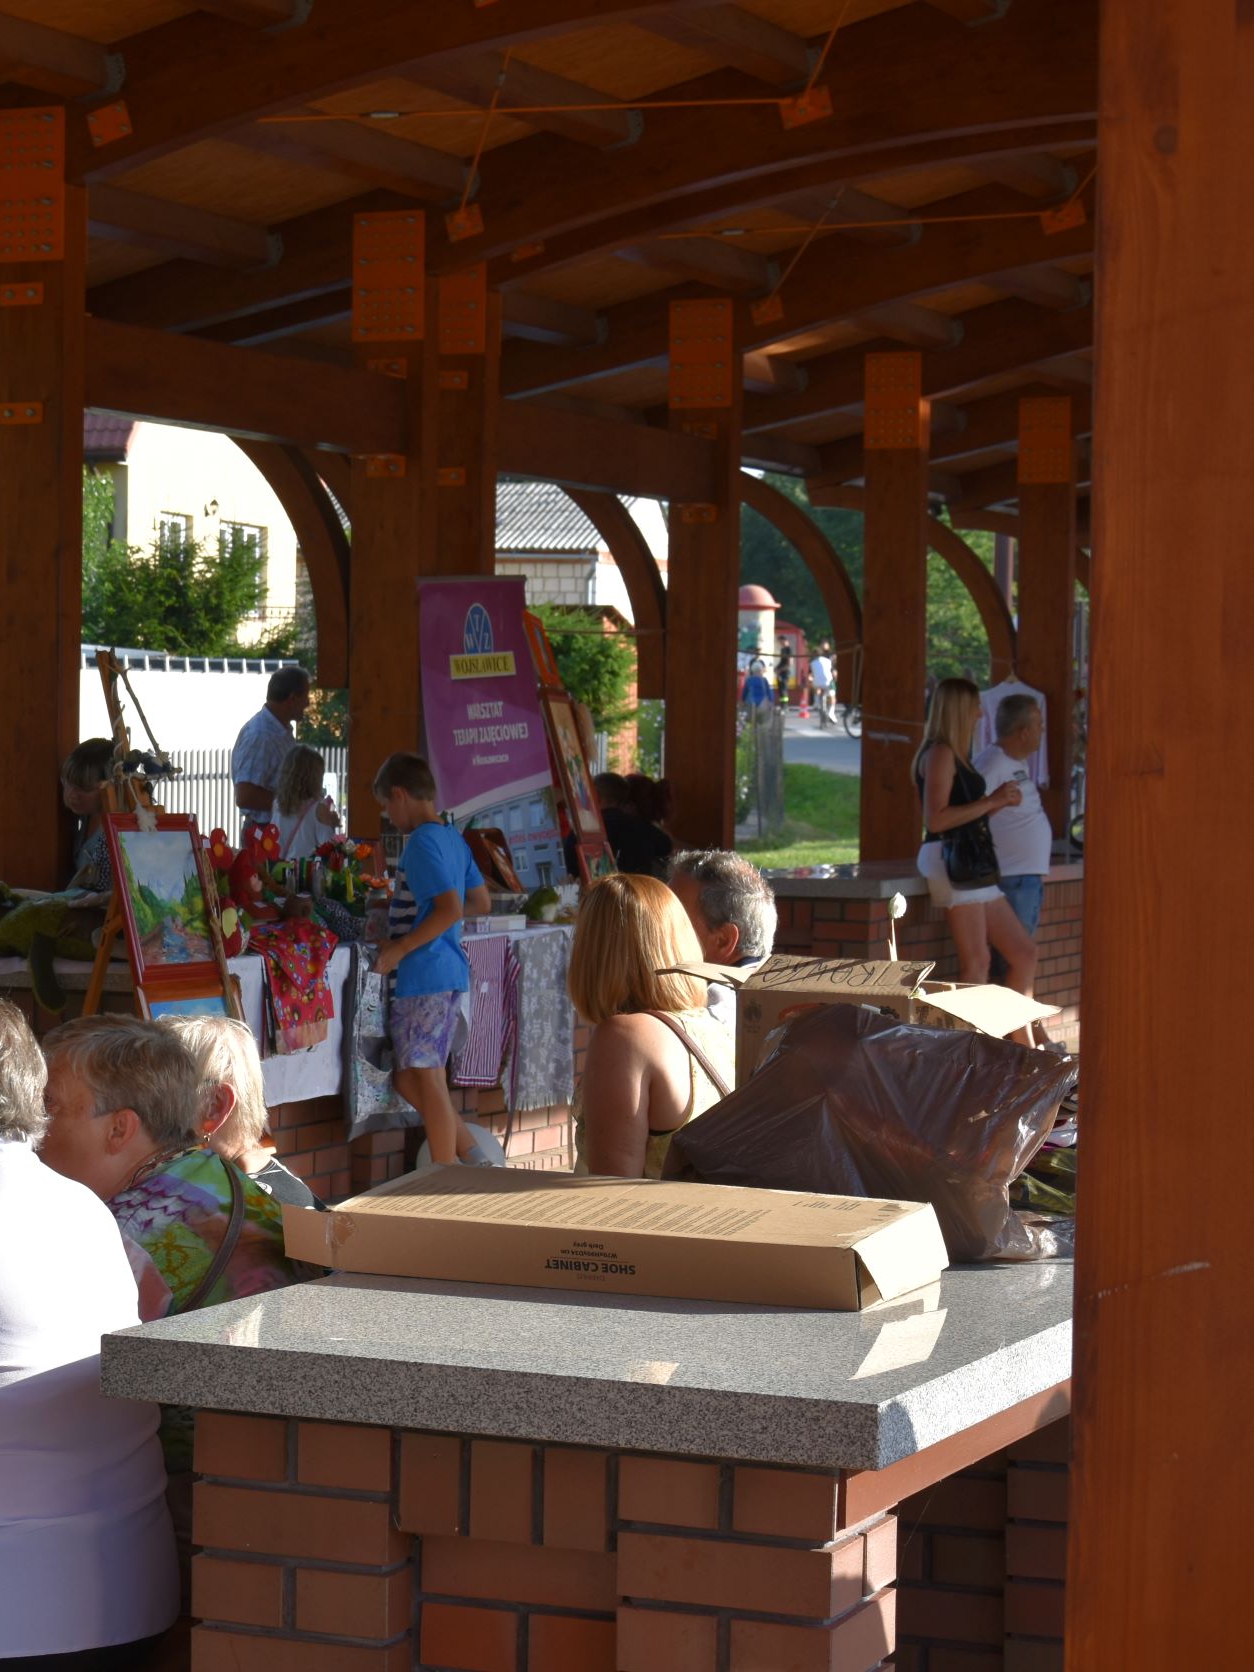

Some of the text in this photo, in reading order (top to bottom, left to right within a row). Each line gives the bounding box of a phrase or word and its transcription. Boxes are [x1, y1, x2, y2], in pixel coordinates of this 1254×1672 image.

[466, 701, 504, 720] WARSZTAT
[545, 1258, 636, 1275] SHOE CABINET
